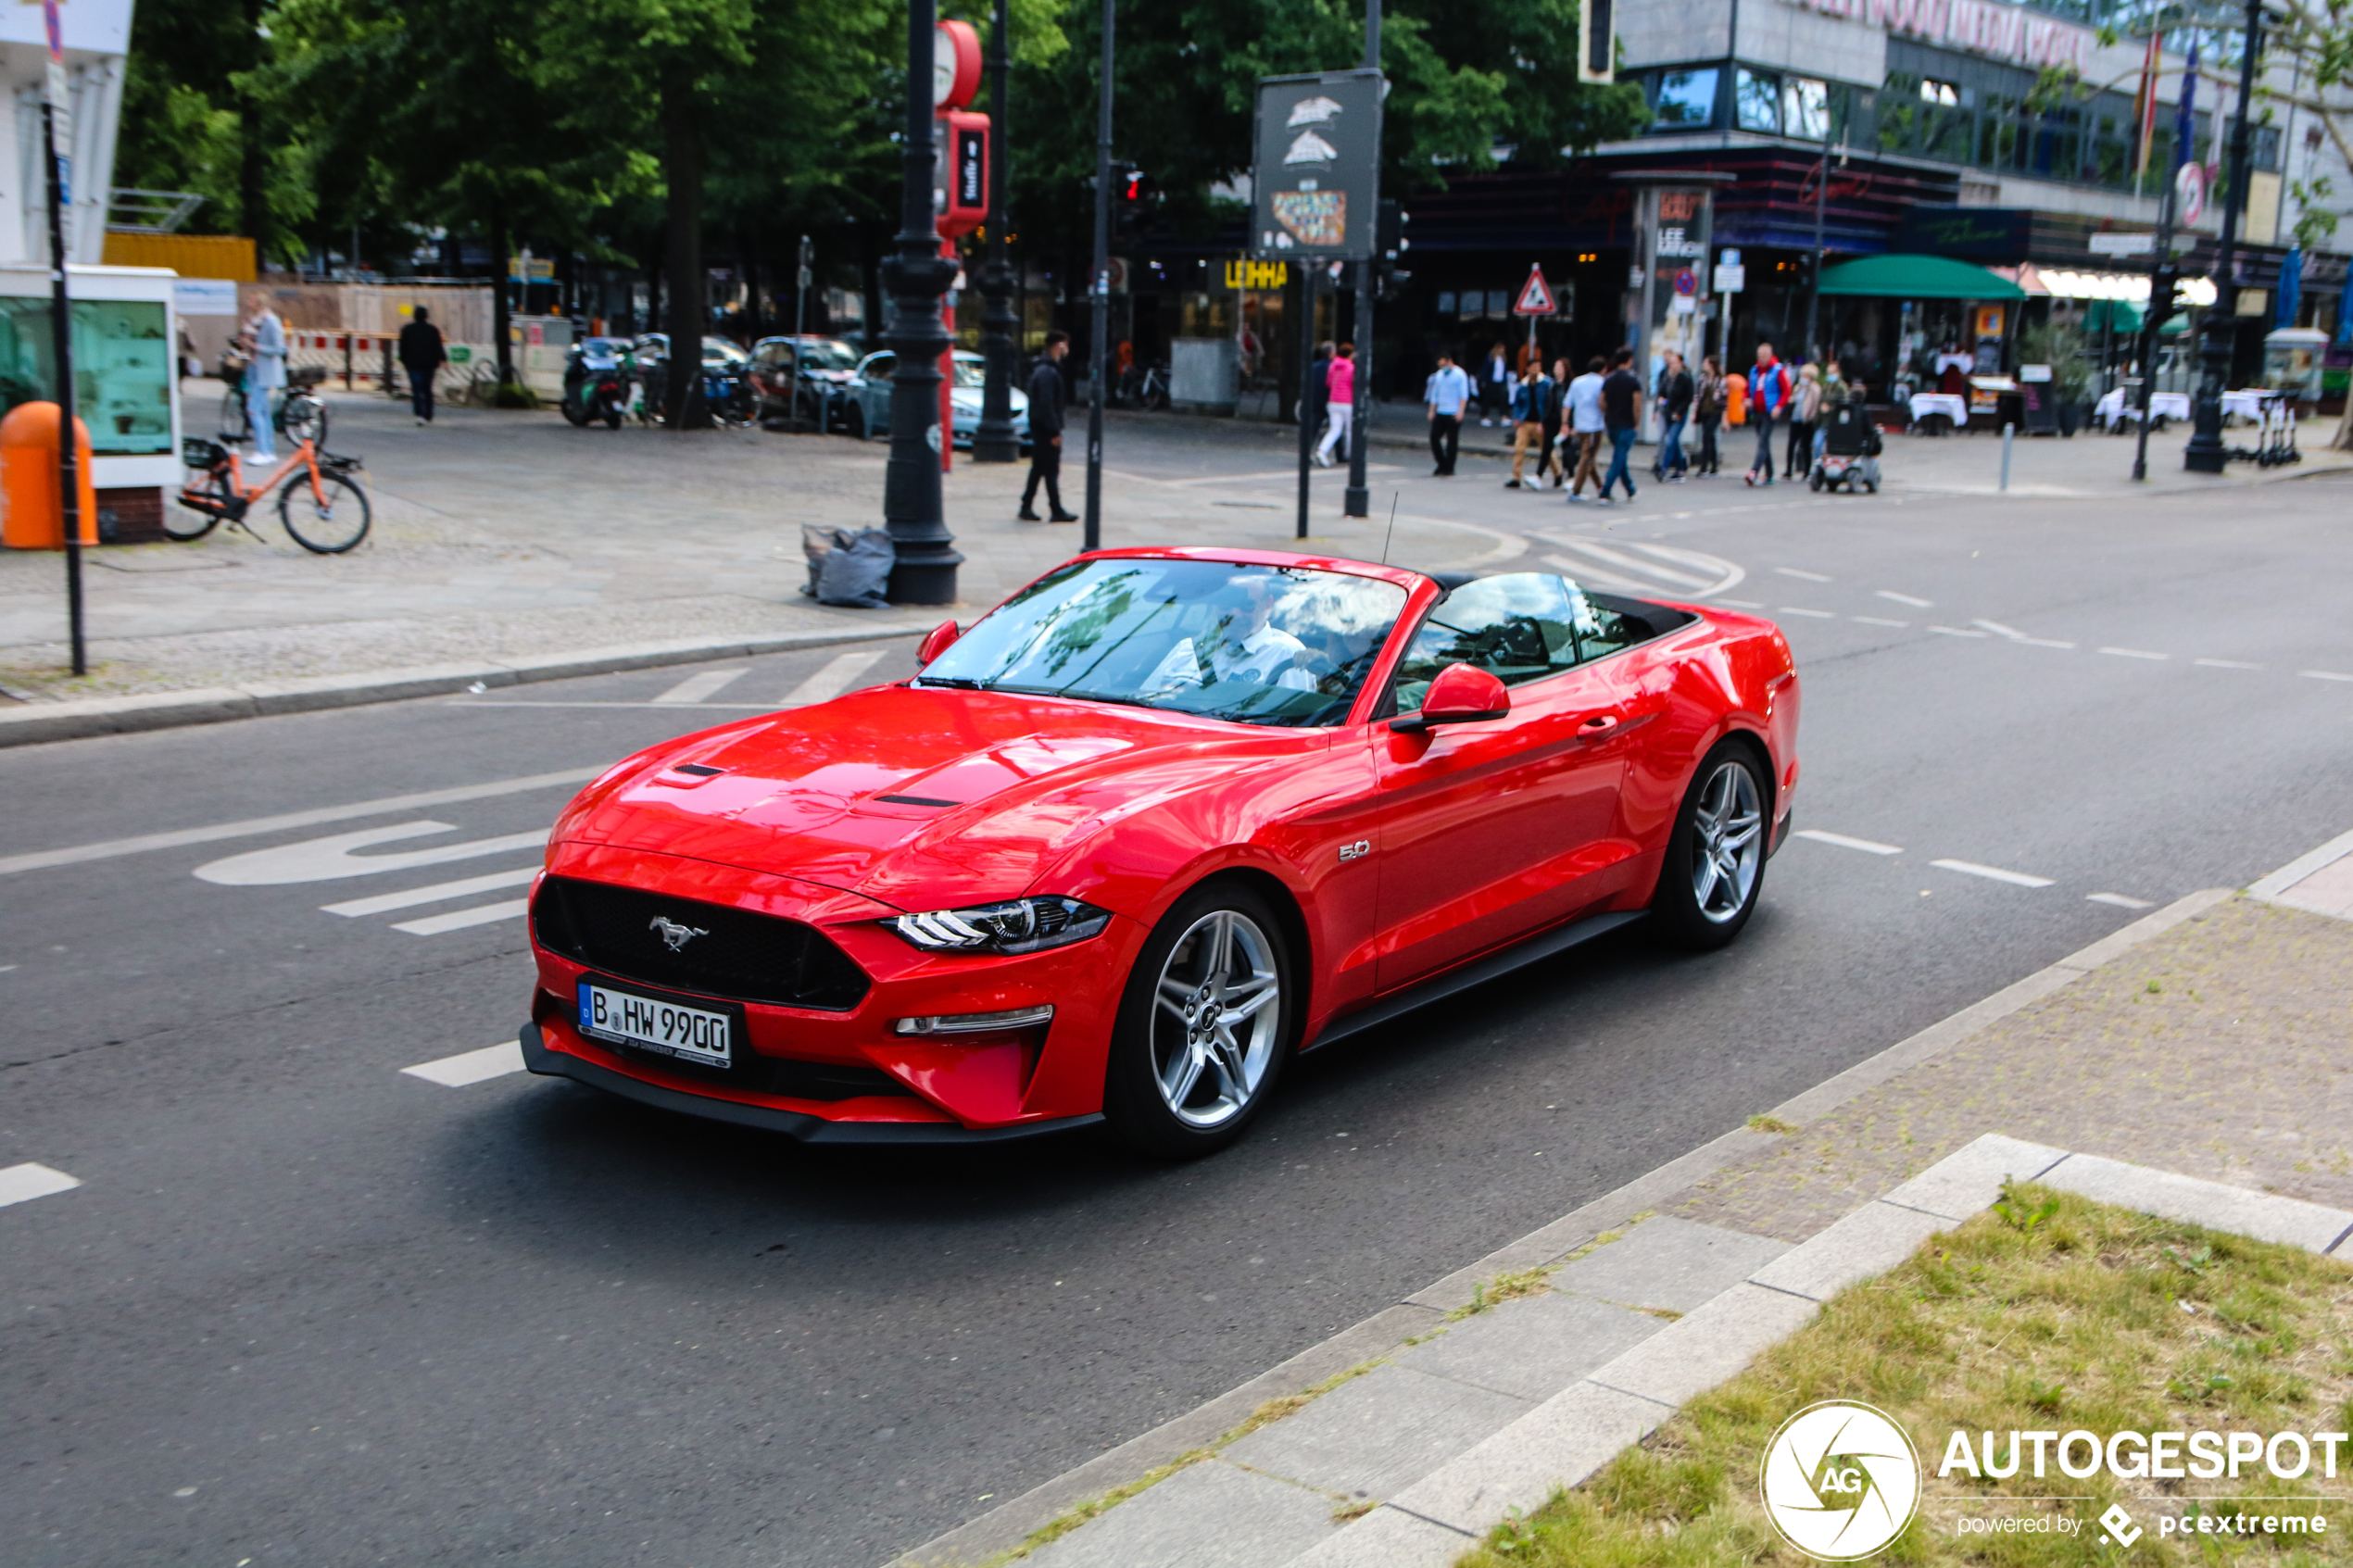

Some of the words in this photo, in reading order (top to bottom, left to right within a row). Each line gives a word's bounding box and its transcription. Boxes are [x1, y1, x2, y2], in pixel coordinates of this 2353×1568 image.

[1340, 840, 1370, 861] 5.0
[593, 991, 608, 1024] B
[624, 998, 654, 1037] HW
[661, 1008, 725, 1052] 9900
